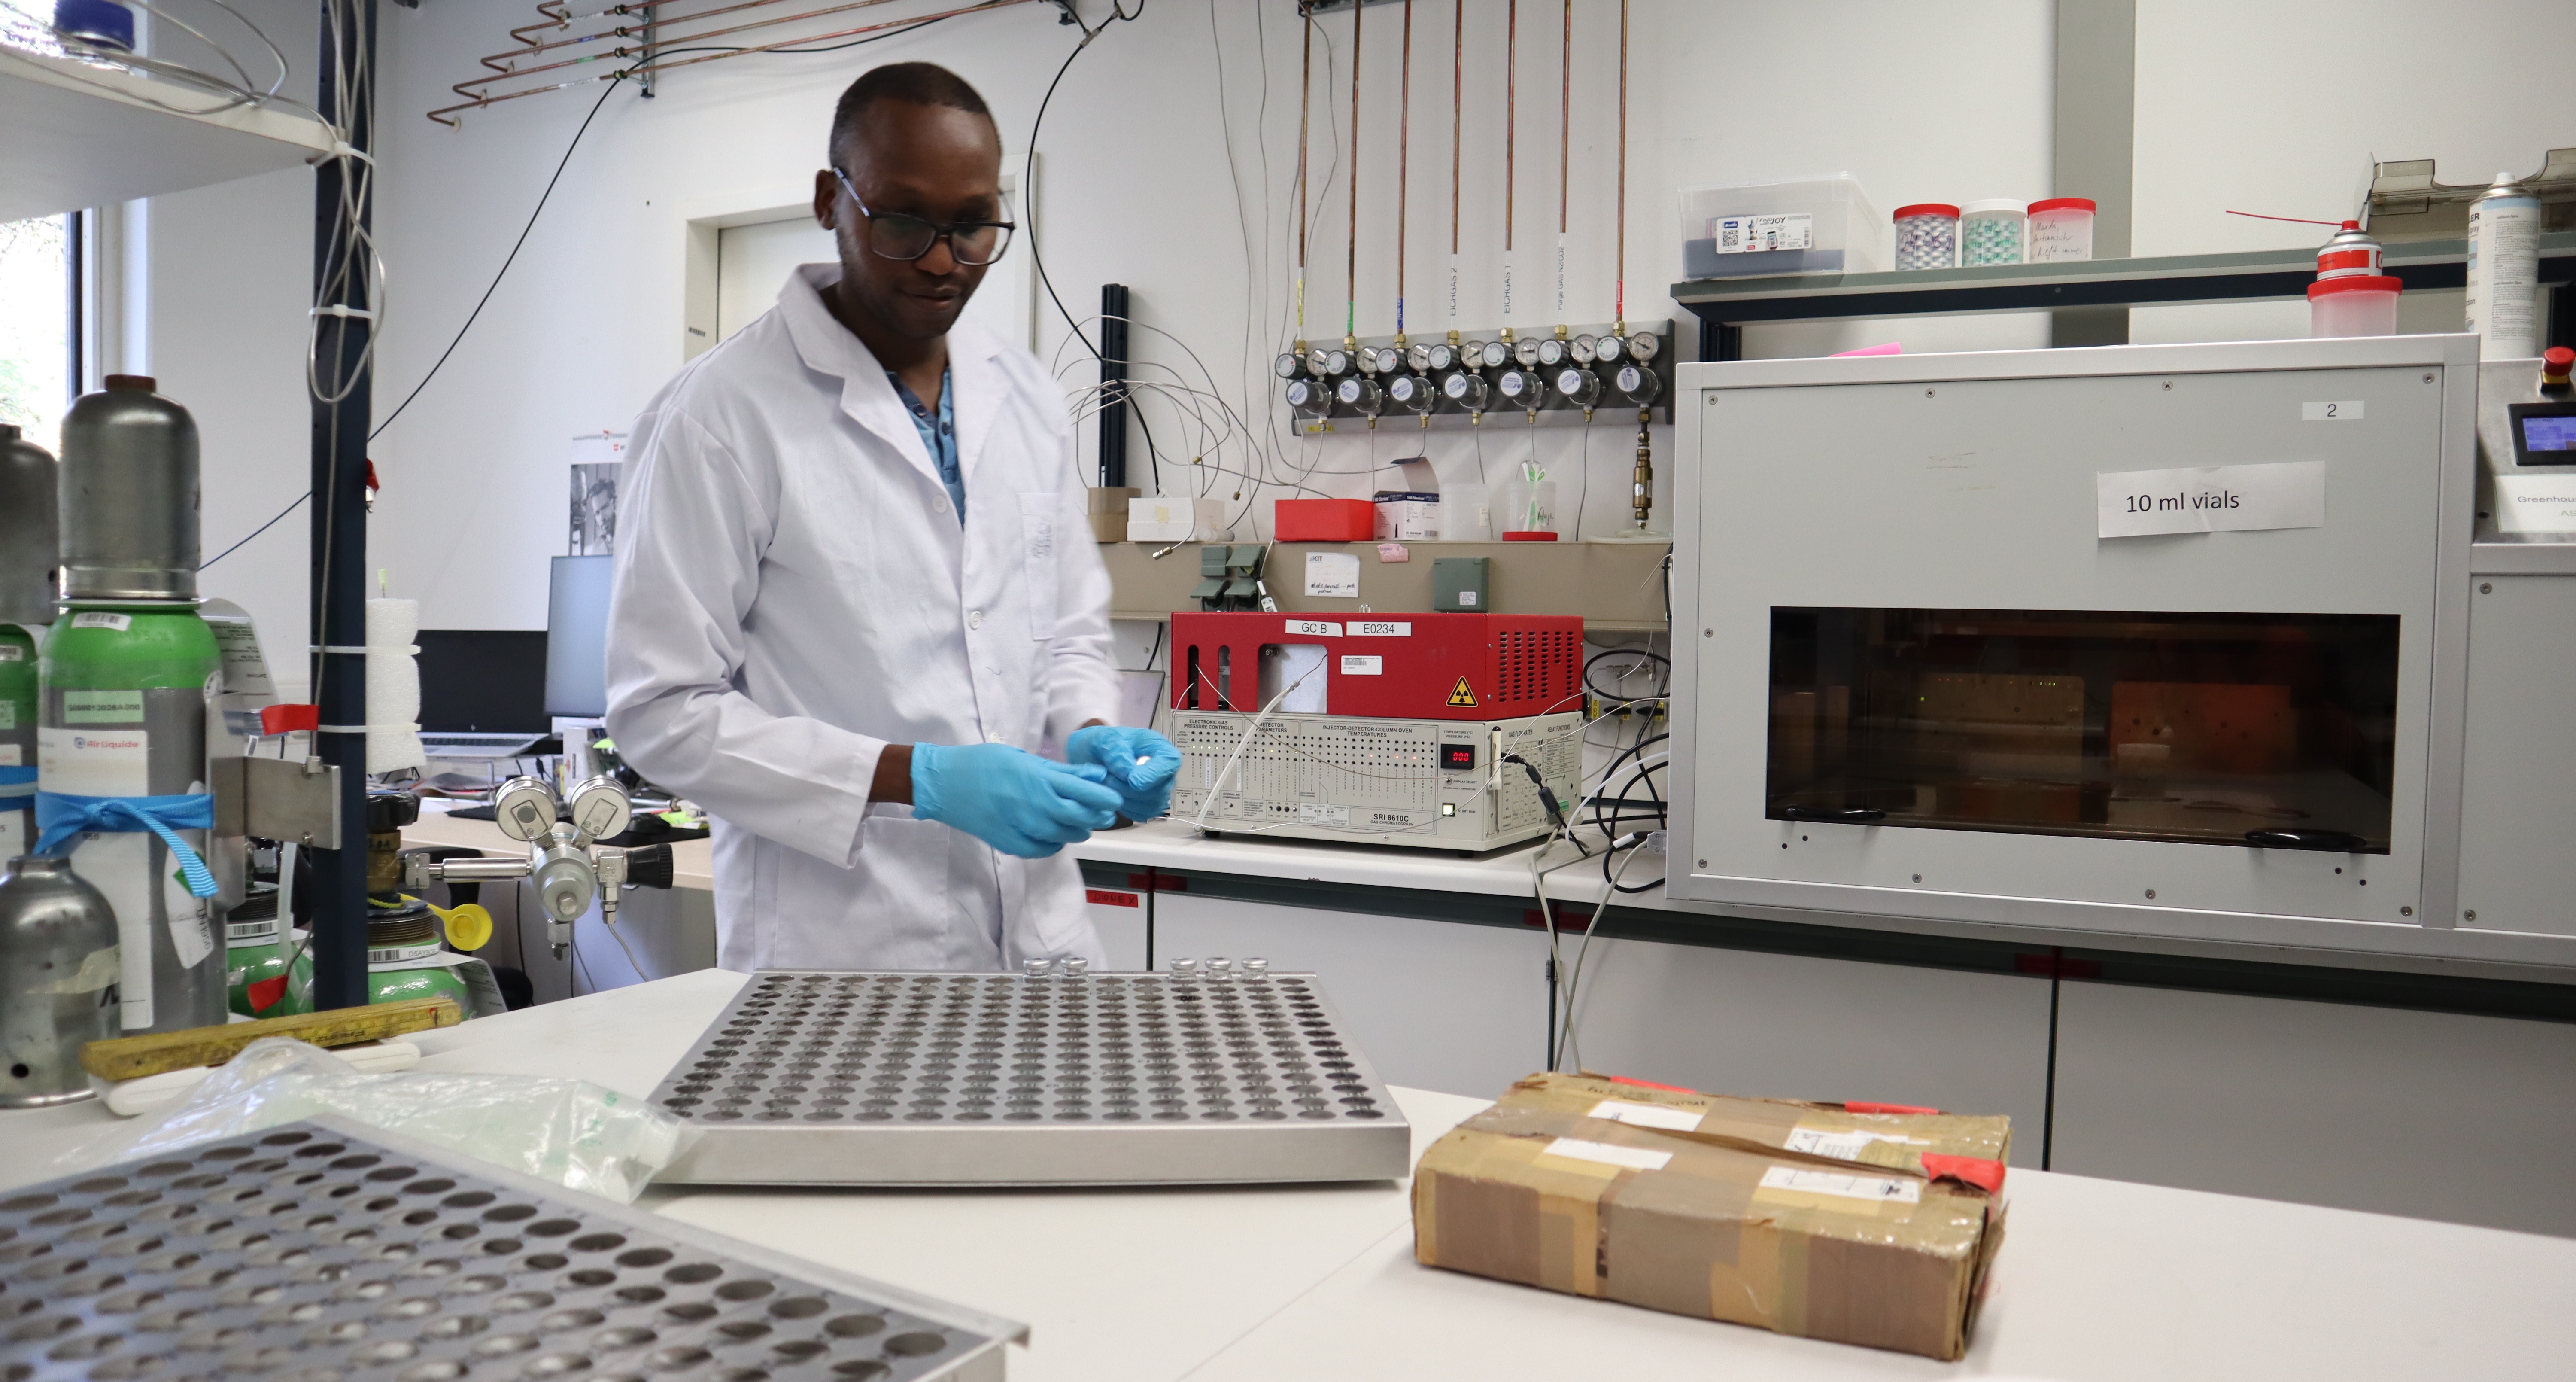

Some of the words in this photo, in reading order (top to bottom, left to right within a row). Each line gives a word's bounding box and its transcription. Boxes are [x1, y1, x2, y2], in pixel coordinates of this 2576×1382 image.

[2327, 404, 2337, 417] 2
[2126, 495, 2151, 513] 10
[2159, 492, 2184, 511] ml
[2192, 490, 2240, 510] vials
[1302, 623, 1317, 633] GC
[1321, 624, 1327, 633] B
[1363, 624, 1395, 634] E0234
[1453, 752, 1469, 762] 000
